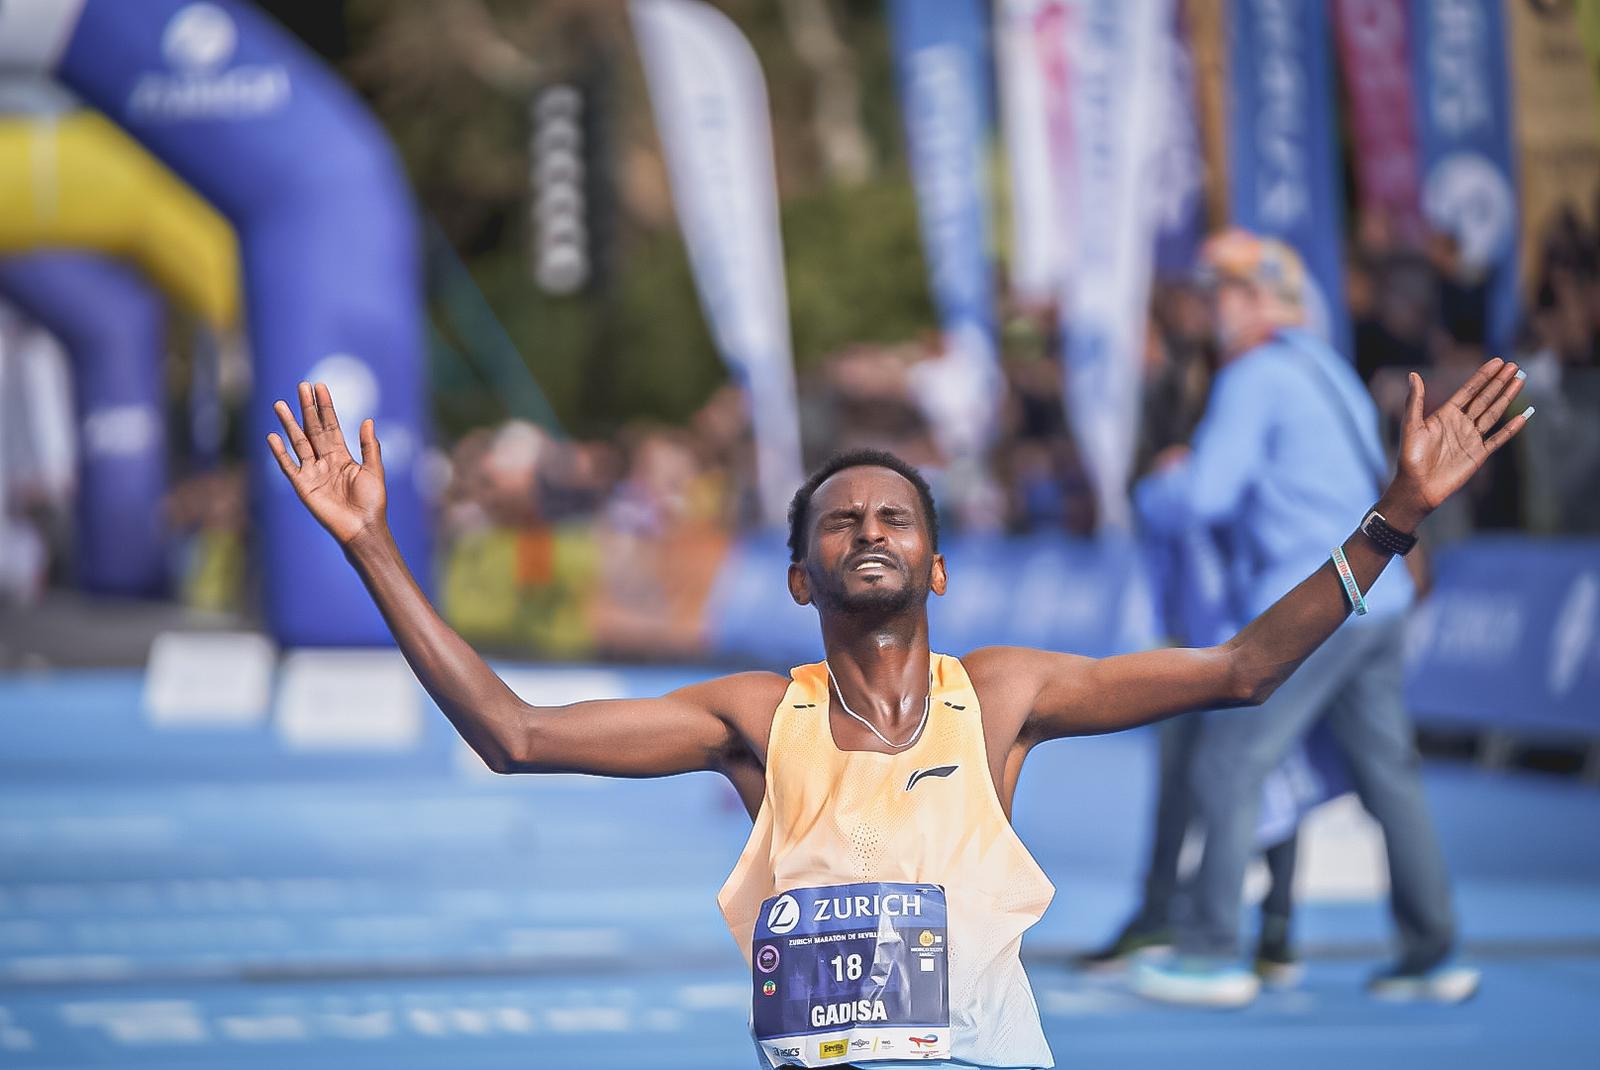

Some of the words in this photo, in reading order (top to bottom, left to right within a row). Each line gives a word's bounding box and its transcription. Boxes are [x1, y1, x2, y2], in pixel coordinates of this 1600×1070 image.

[813, 894, 922, 922] ZURICH
[789, 937, 813, 946] ZURICH
[814, 935, 846, 945] MARATON
[858, 931, 881, 939] SEVILL
[831, 953, 862, 982] 18
[811, 999, 888, 1027] GADISA
